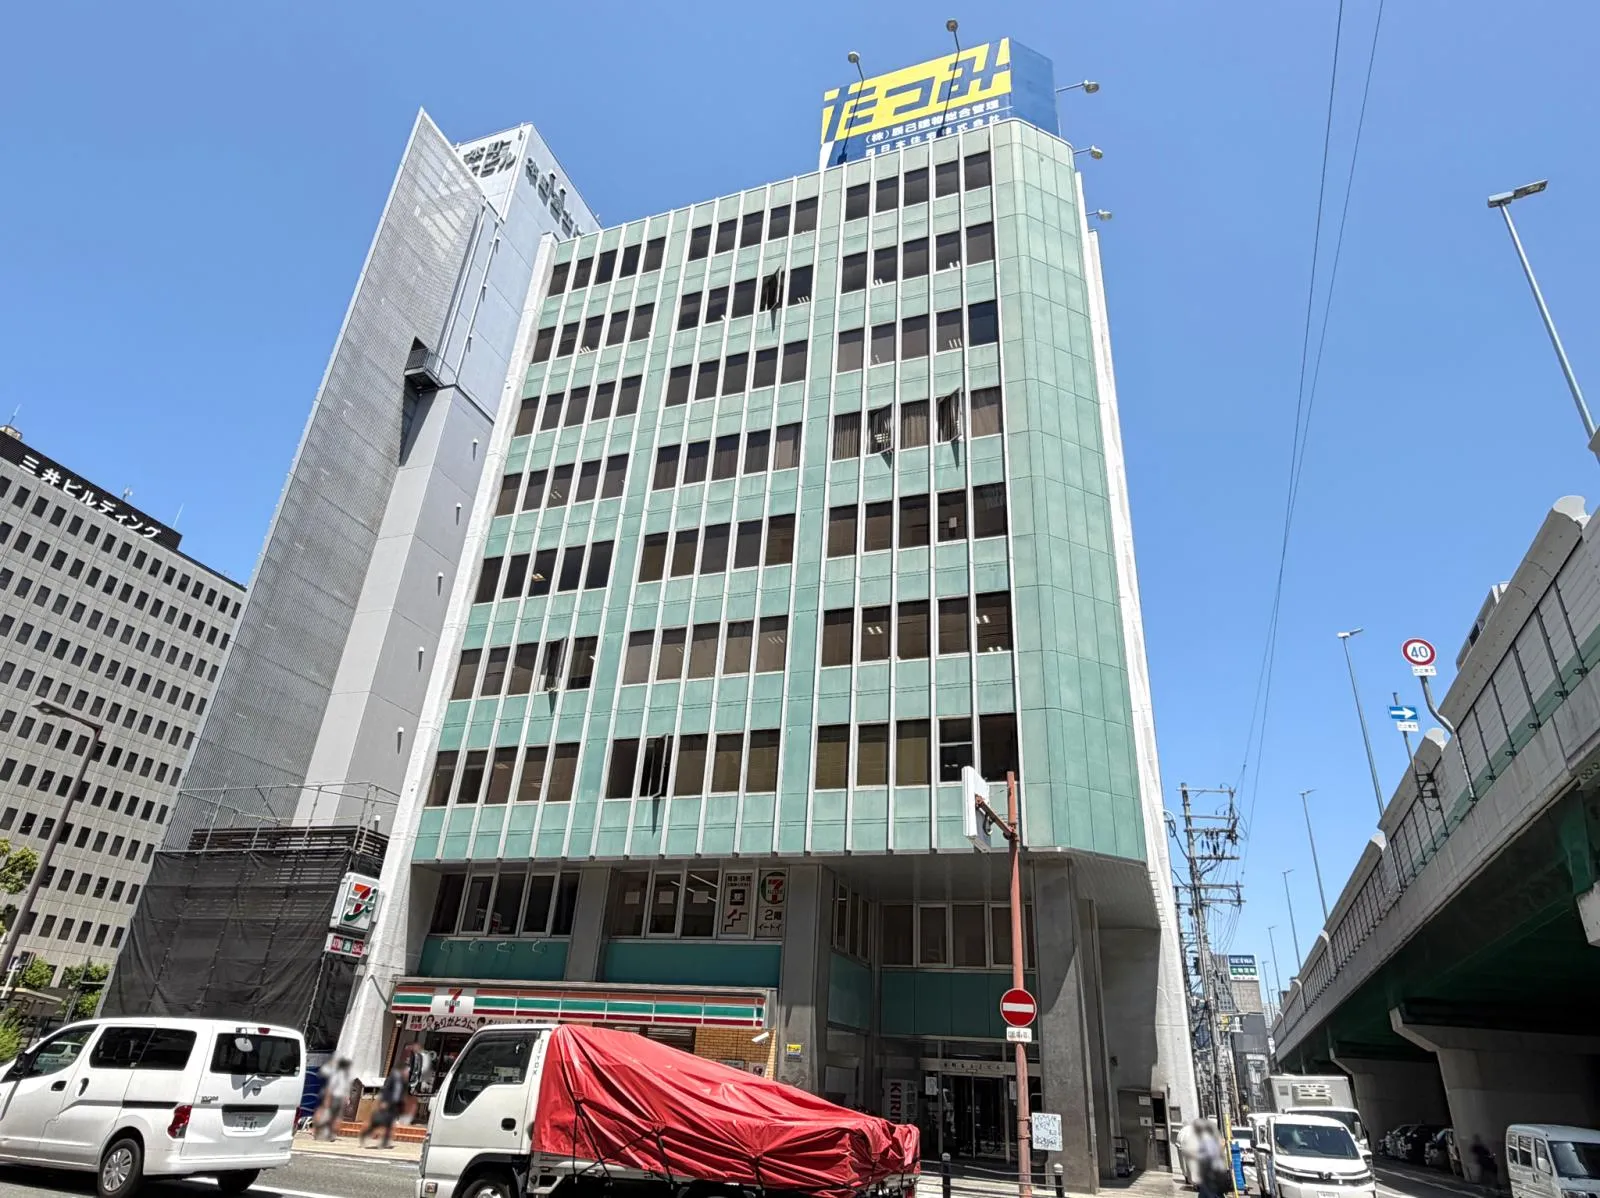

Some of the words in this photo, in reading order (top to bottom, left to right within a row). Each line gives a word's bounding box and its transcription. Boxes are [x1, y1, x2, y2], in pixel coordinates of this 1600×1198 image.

[19, 454, 161, 538] 三井ビルディング
[1411, 646, 1428, 658] 40
